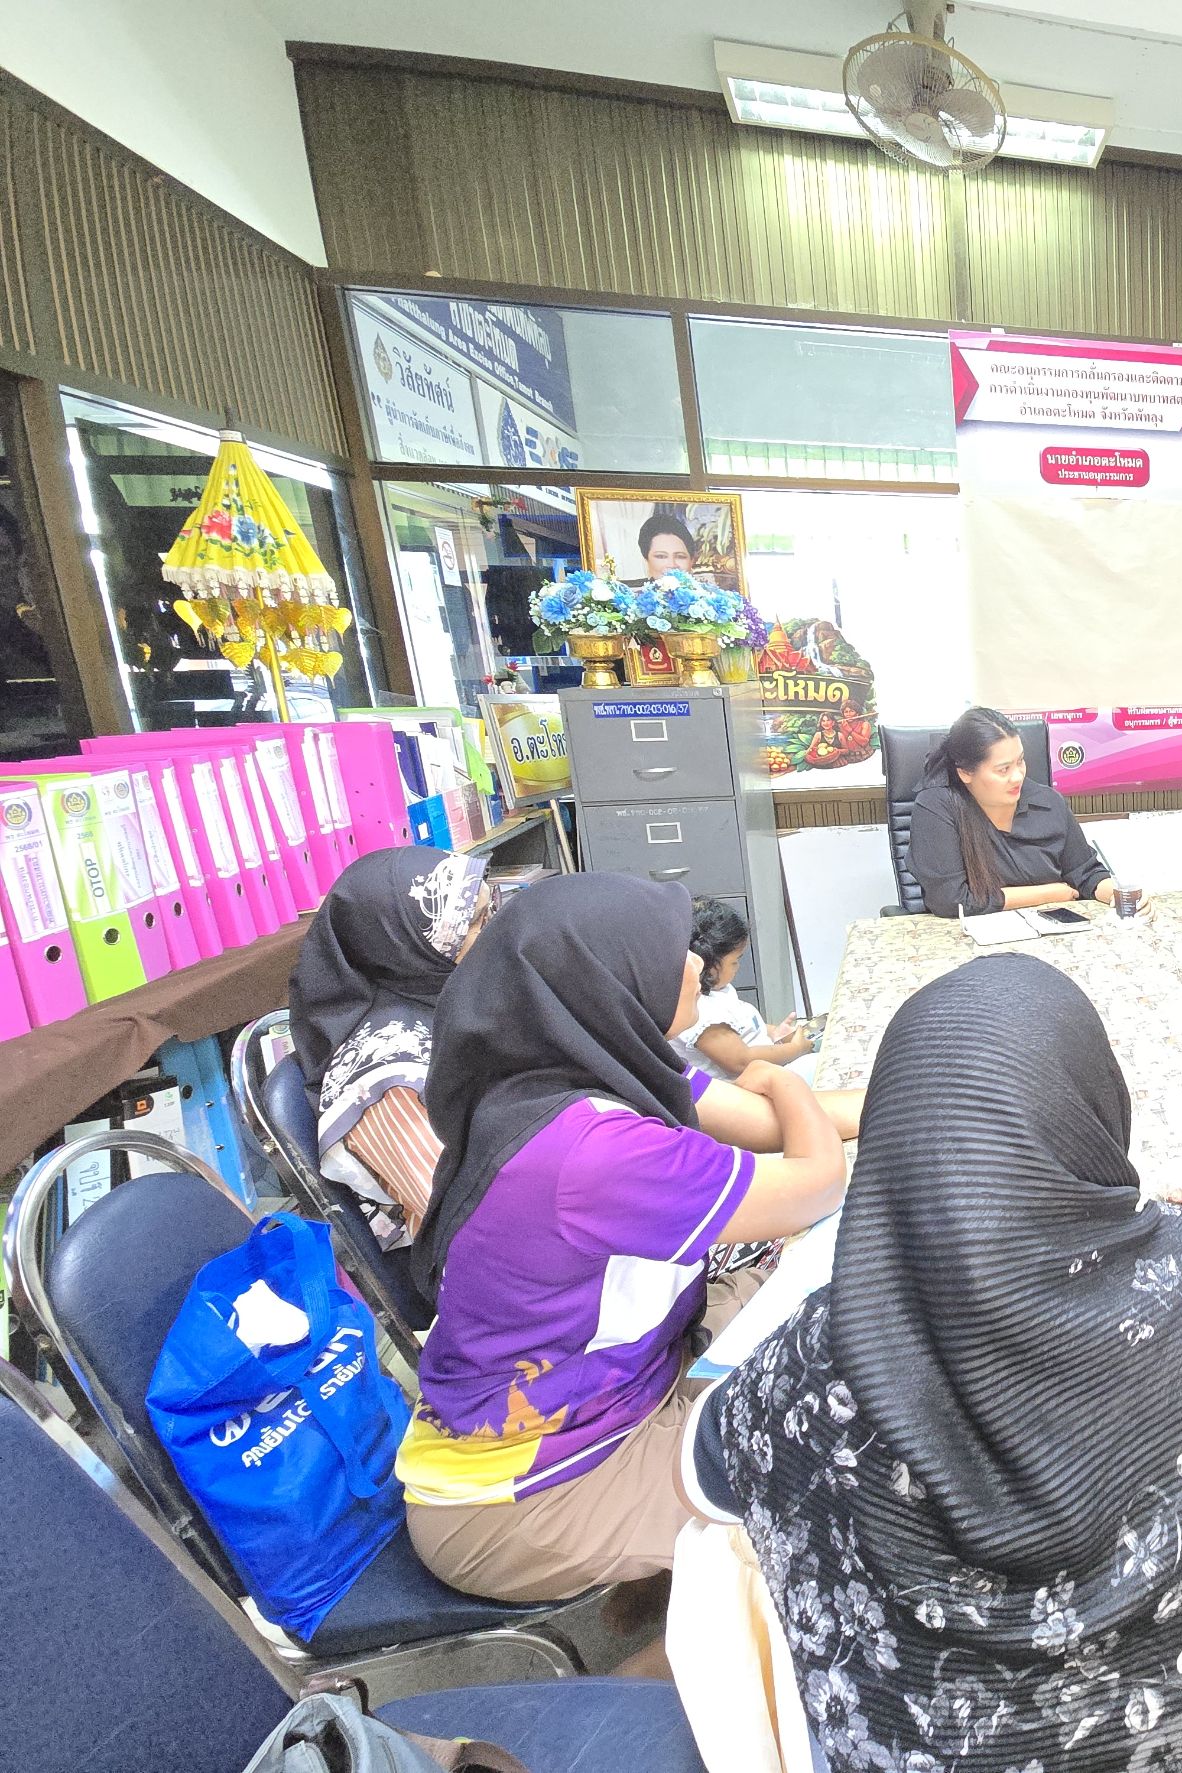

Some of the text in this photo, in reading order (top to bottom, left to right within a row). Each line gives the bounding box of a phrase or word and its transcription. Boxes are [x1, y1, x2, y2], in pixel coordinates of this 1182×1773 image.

[392, 346, 455, 414] วิสัยทัศน์
[448, 329, 467, 353] Area
[469, 343, 493, 370] Excise
[534, 390, 554, 414] Branch
[1019, 402, 1164, 427] อำเภอตะโหมด จังหวัดพัทลุง
[1046, 450, 1143, 468] นายอำเภอตะโหมด
[1058, 469, 1134, 483] ประธานอนุกรรมการ
[760, 670, 850, 703] ะโหมด
[511, 719, 567, 762] อ.ตะโห
[85, 858, 105, 898] OTOP
